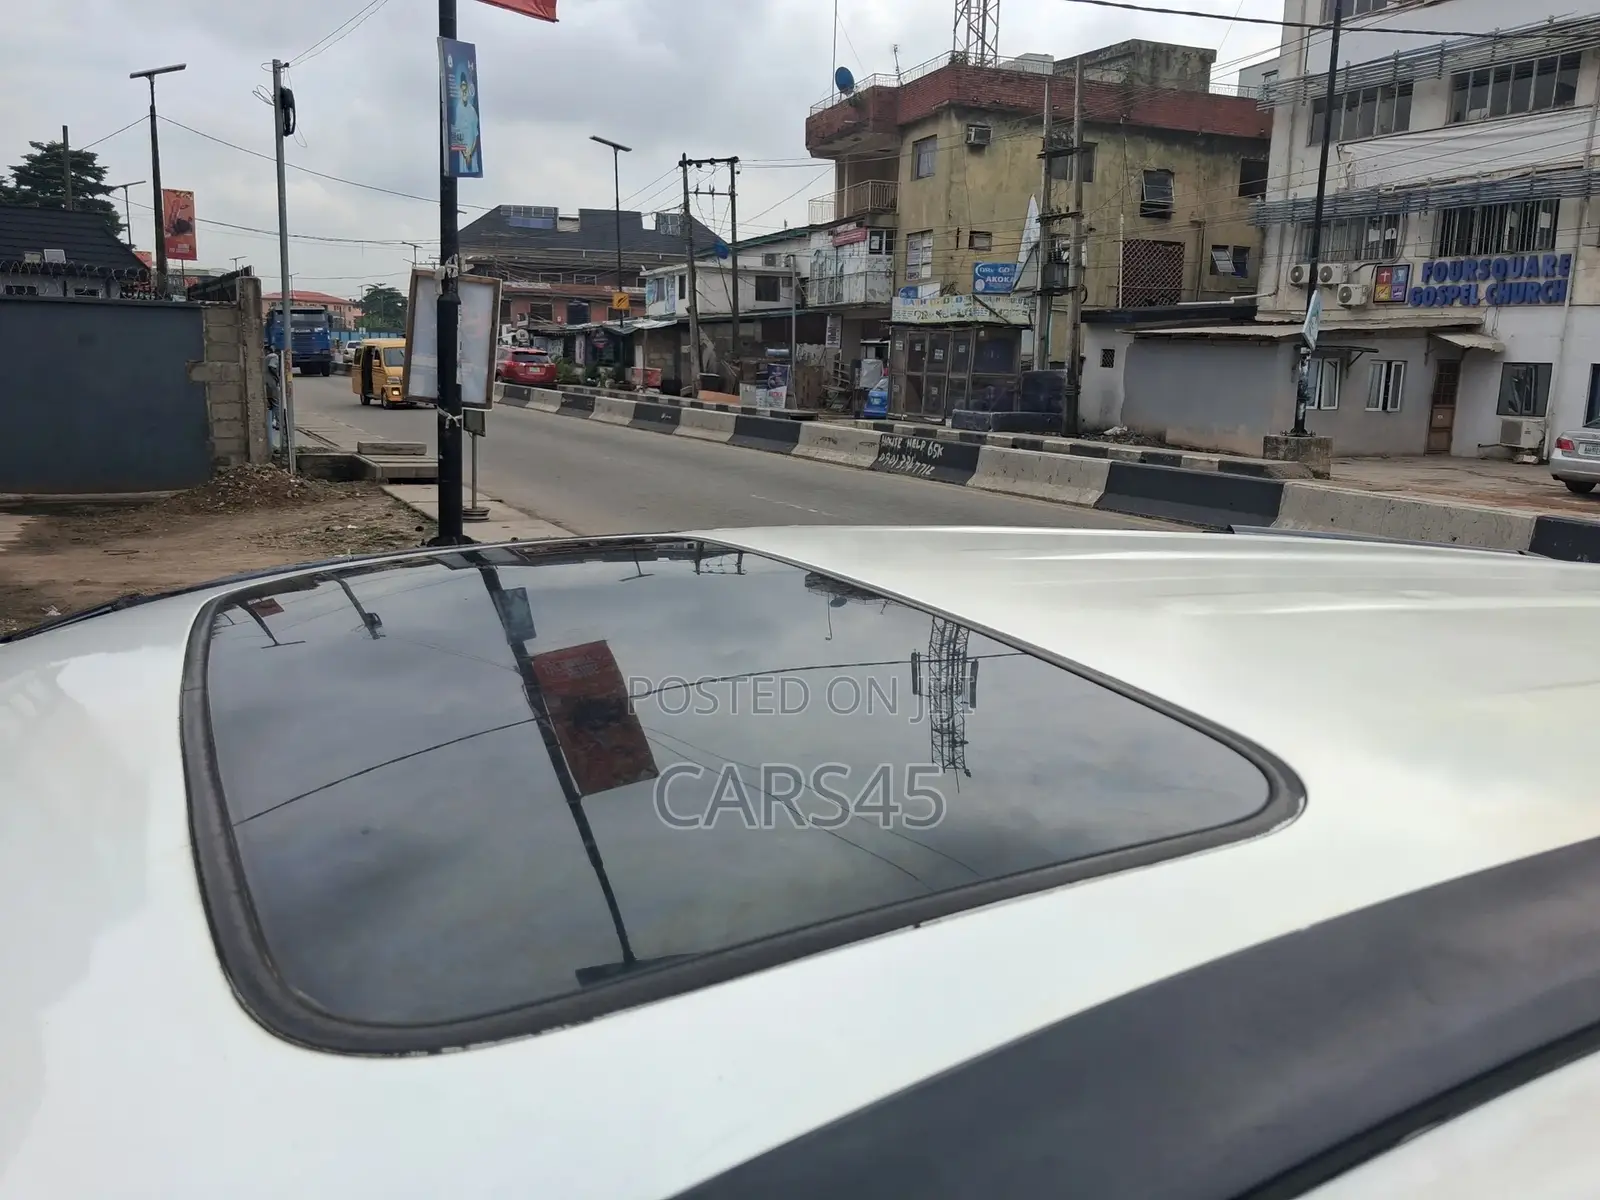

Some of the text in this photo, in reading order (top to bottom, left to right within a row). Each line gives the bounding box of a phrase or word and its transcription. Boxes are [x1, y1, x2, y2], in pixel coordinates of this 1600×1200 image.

[1421, 254, 1572, 284] FOURSQUARE
[1409, 279, 1568, 307] GOSPEL CHURCH
[881, 435, 944, 458] HOUSE HELP 65K
